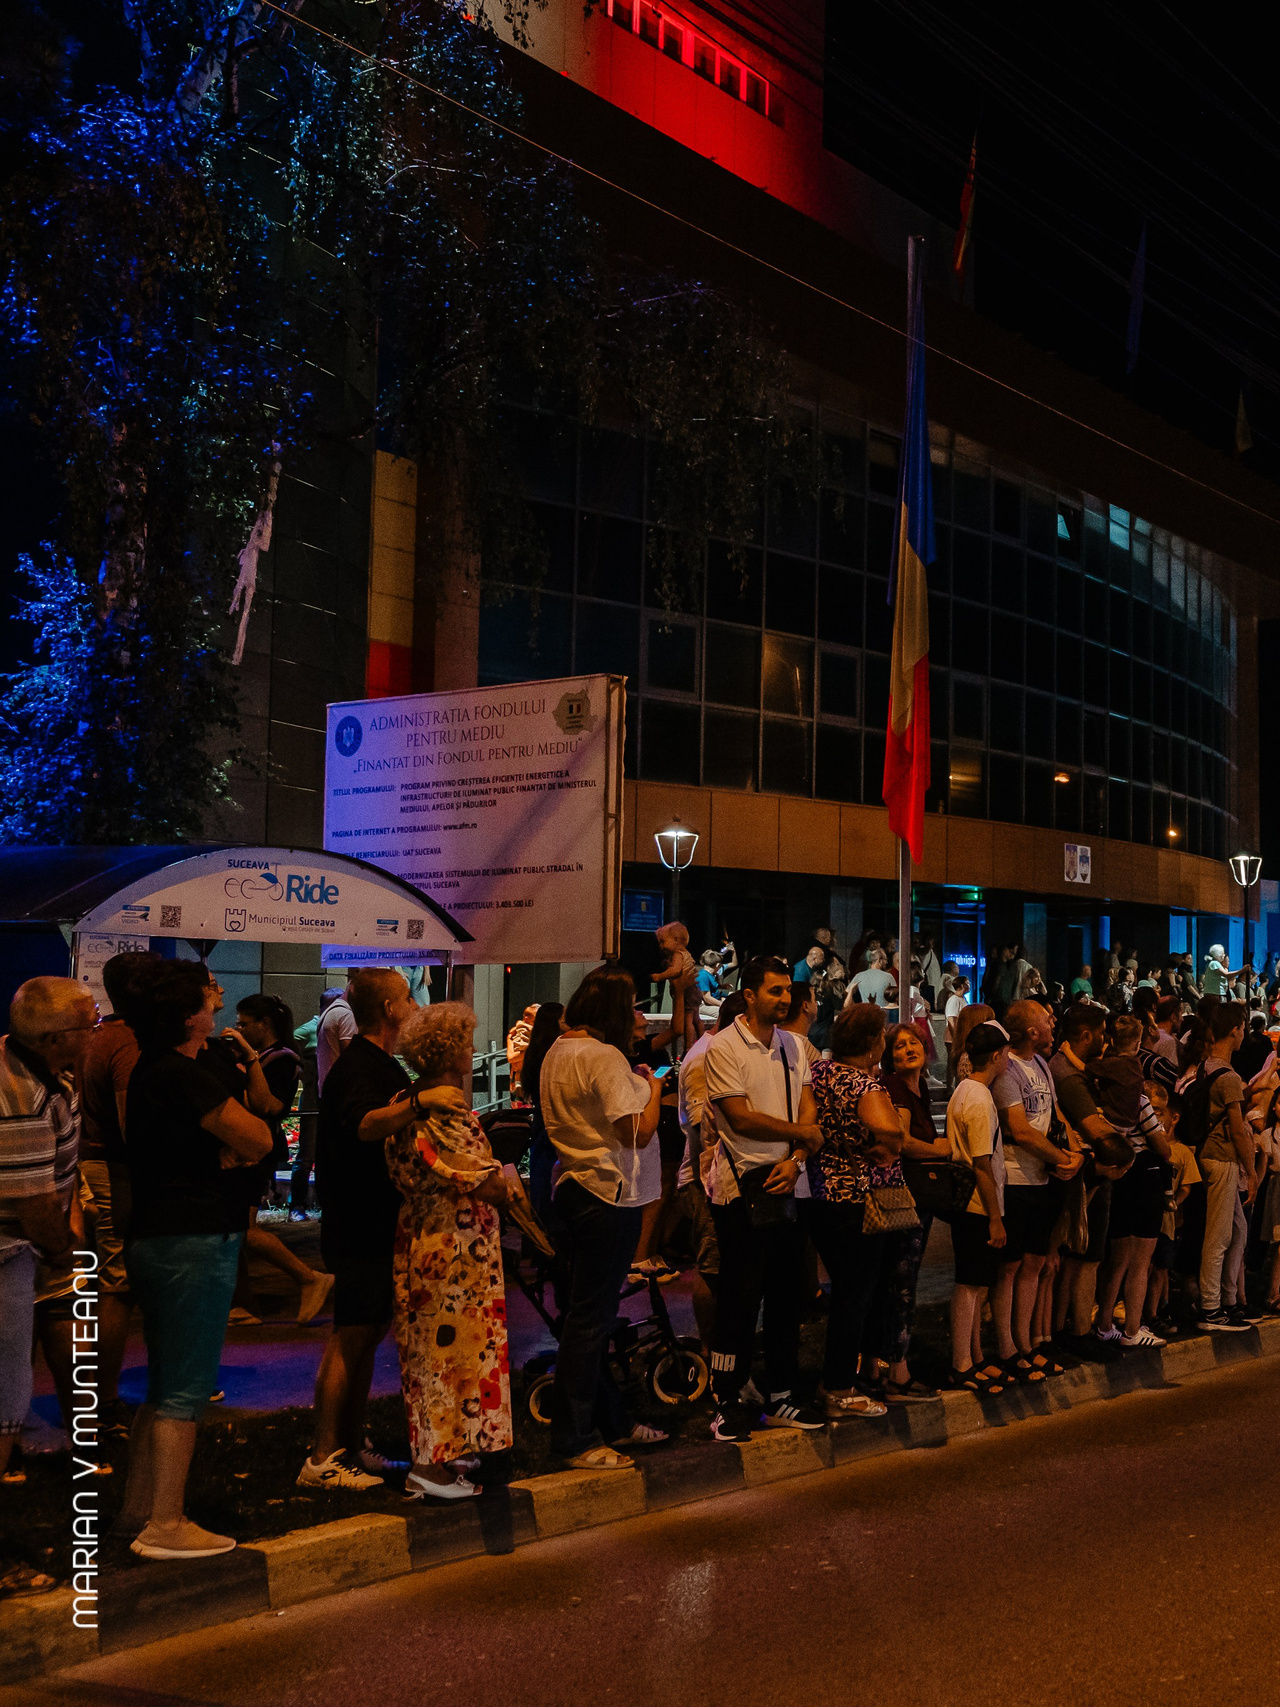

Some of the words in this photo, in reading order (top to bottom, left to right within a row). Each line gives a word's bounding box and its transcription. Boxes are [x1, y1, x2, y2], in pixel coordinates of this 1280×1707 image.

[474, 699, 546, 720] FONDULUI
[406, 729, 457, 748] PENTRU
[460, 724, 505, 741] MEDIU
[413, 754, 434, 768] DIN
[437, 749, 485, 766] FONDUL
[488, 744, 534, 761] PENTRU
[352, 785, 396, 795] PROGRAMULUI:
[400, 781, 430, 791] PROGRAM
[431, 779, 456, 788] PRIVIND
[525, 770, 563, 780] ENERGETICE
[453, 790, 461, 798] DE
[462, 788, 491, 797] ILUMINAT
[493, 786, 515, 795] PUBLIC
[547, 782, 556, 790] DE
[558, 780, 597, 790] MINISTERUL
[431, 802, 454, 811] APELOR
[332, 830, 353, 838] PAGINA
[354, 829, 362, 837] DE
[362, 827, 391, 836] INTERNET
[396, 824, 442, 834] PROGRAMULUI:
[402, 849, 414, 857] UAT
[415, 847, 442, 856] SUCEAVA
[227, 858, 270, 871] SUCEAVA
[445, 869, 481, 878] SISTEMULUI
[481, 868, 490, 877] DE
[491, 867, 521, 876] ILUMINAT
[523, 865, 545, 874] PUBLIC
[546, 864, 574, 873] STRADAL
[286, 874, 339, 905] Ride
[433, 880, 460, 889] SUCEAVA
[453, 901, 494, 910] PROIECTULUI:
[248, 914, 297, 926] Municipiul
[299, 916, 335, 927] Suceava
